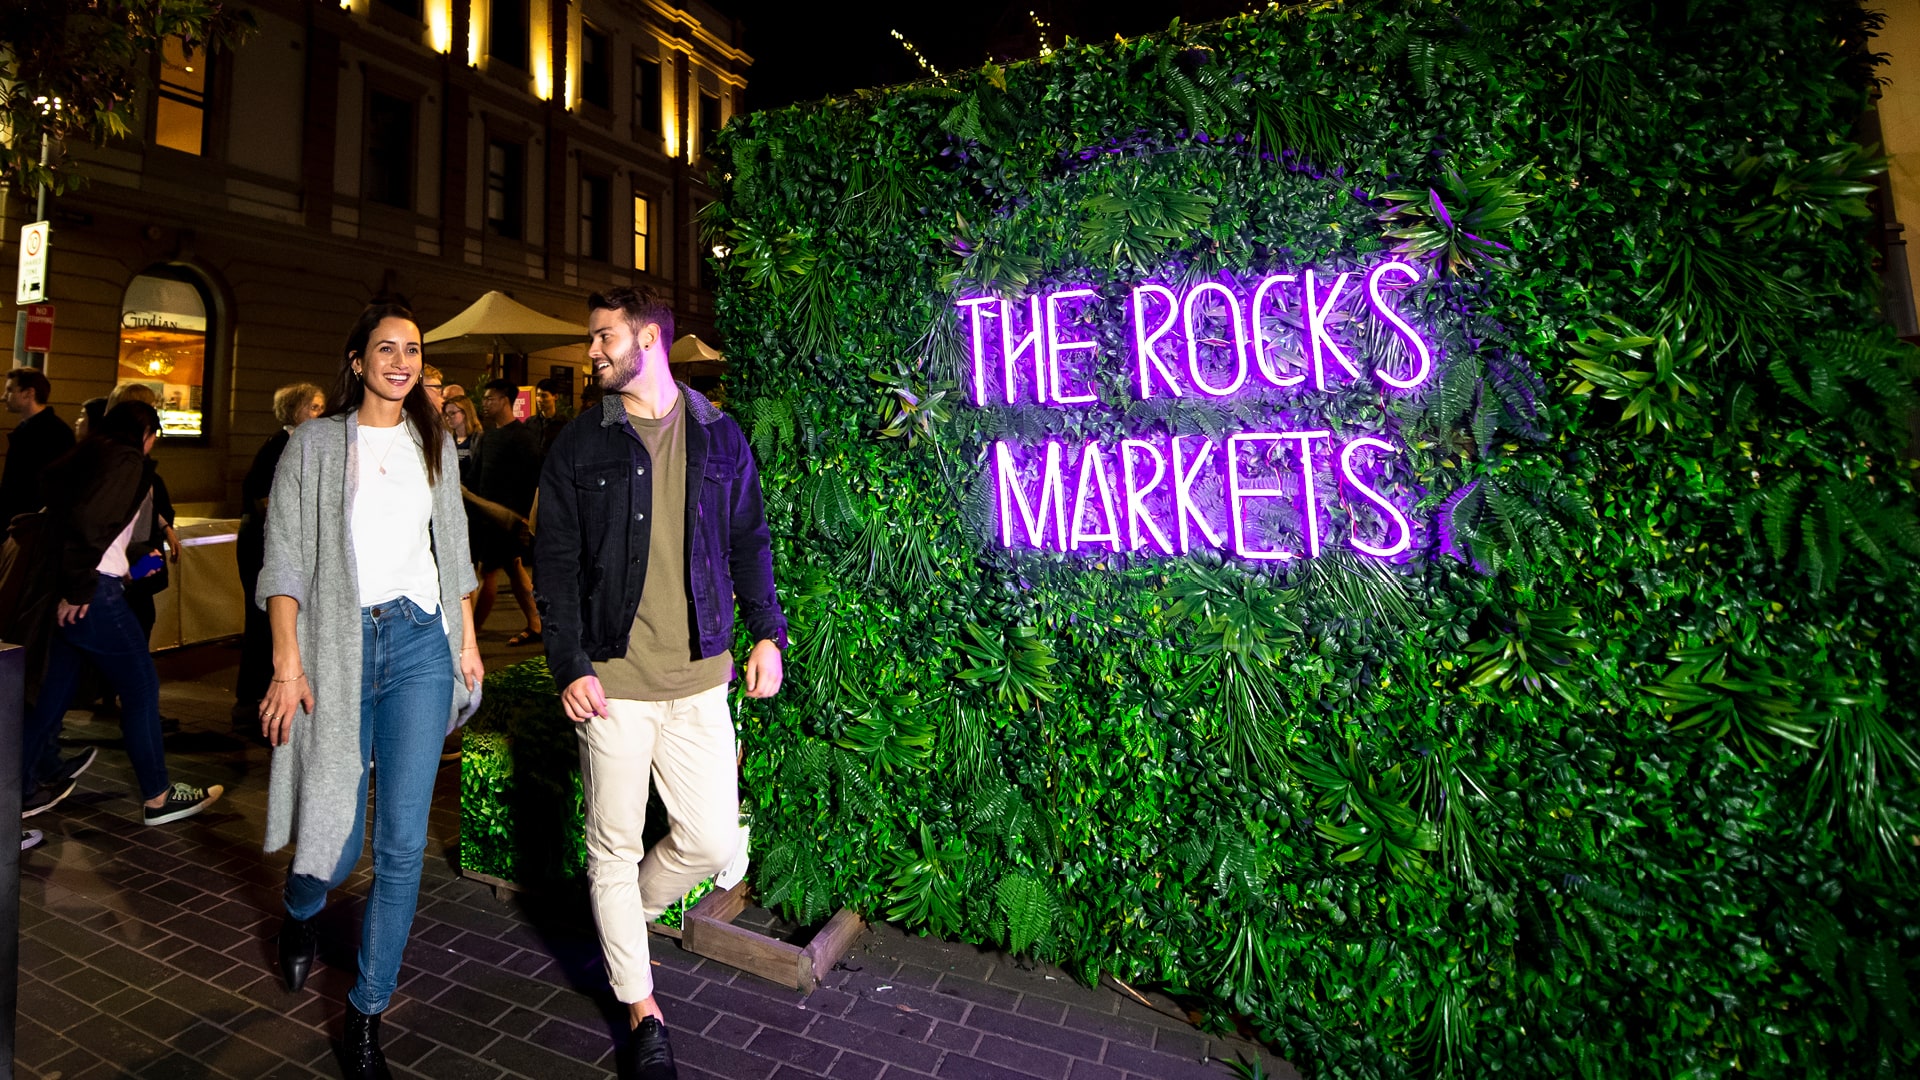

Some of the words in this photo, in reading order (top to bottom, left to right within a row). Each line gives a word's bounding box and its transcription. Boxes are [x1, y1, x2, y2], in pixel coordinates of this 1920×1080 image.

[36, 306, 48, 316] NO
[957, 289, 1098, 407] THE
[1132, 260, 1432, 400] ROCKS
[995, 430, 1412, 561] MARKETS
